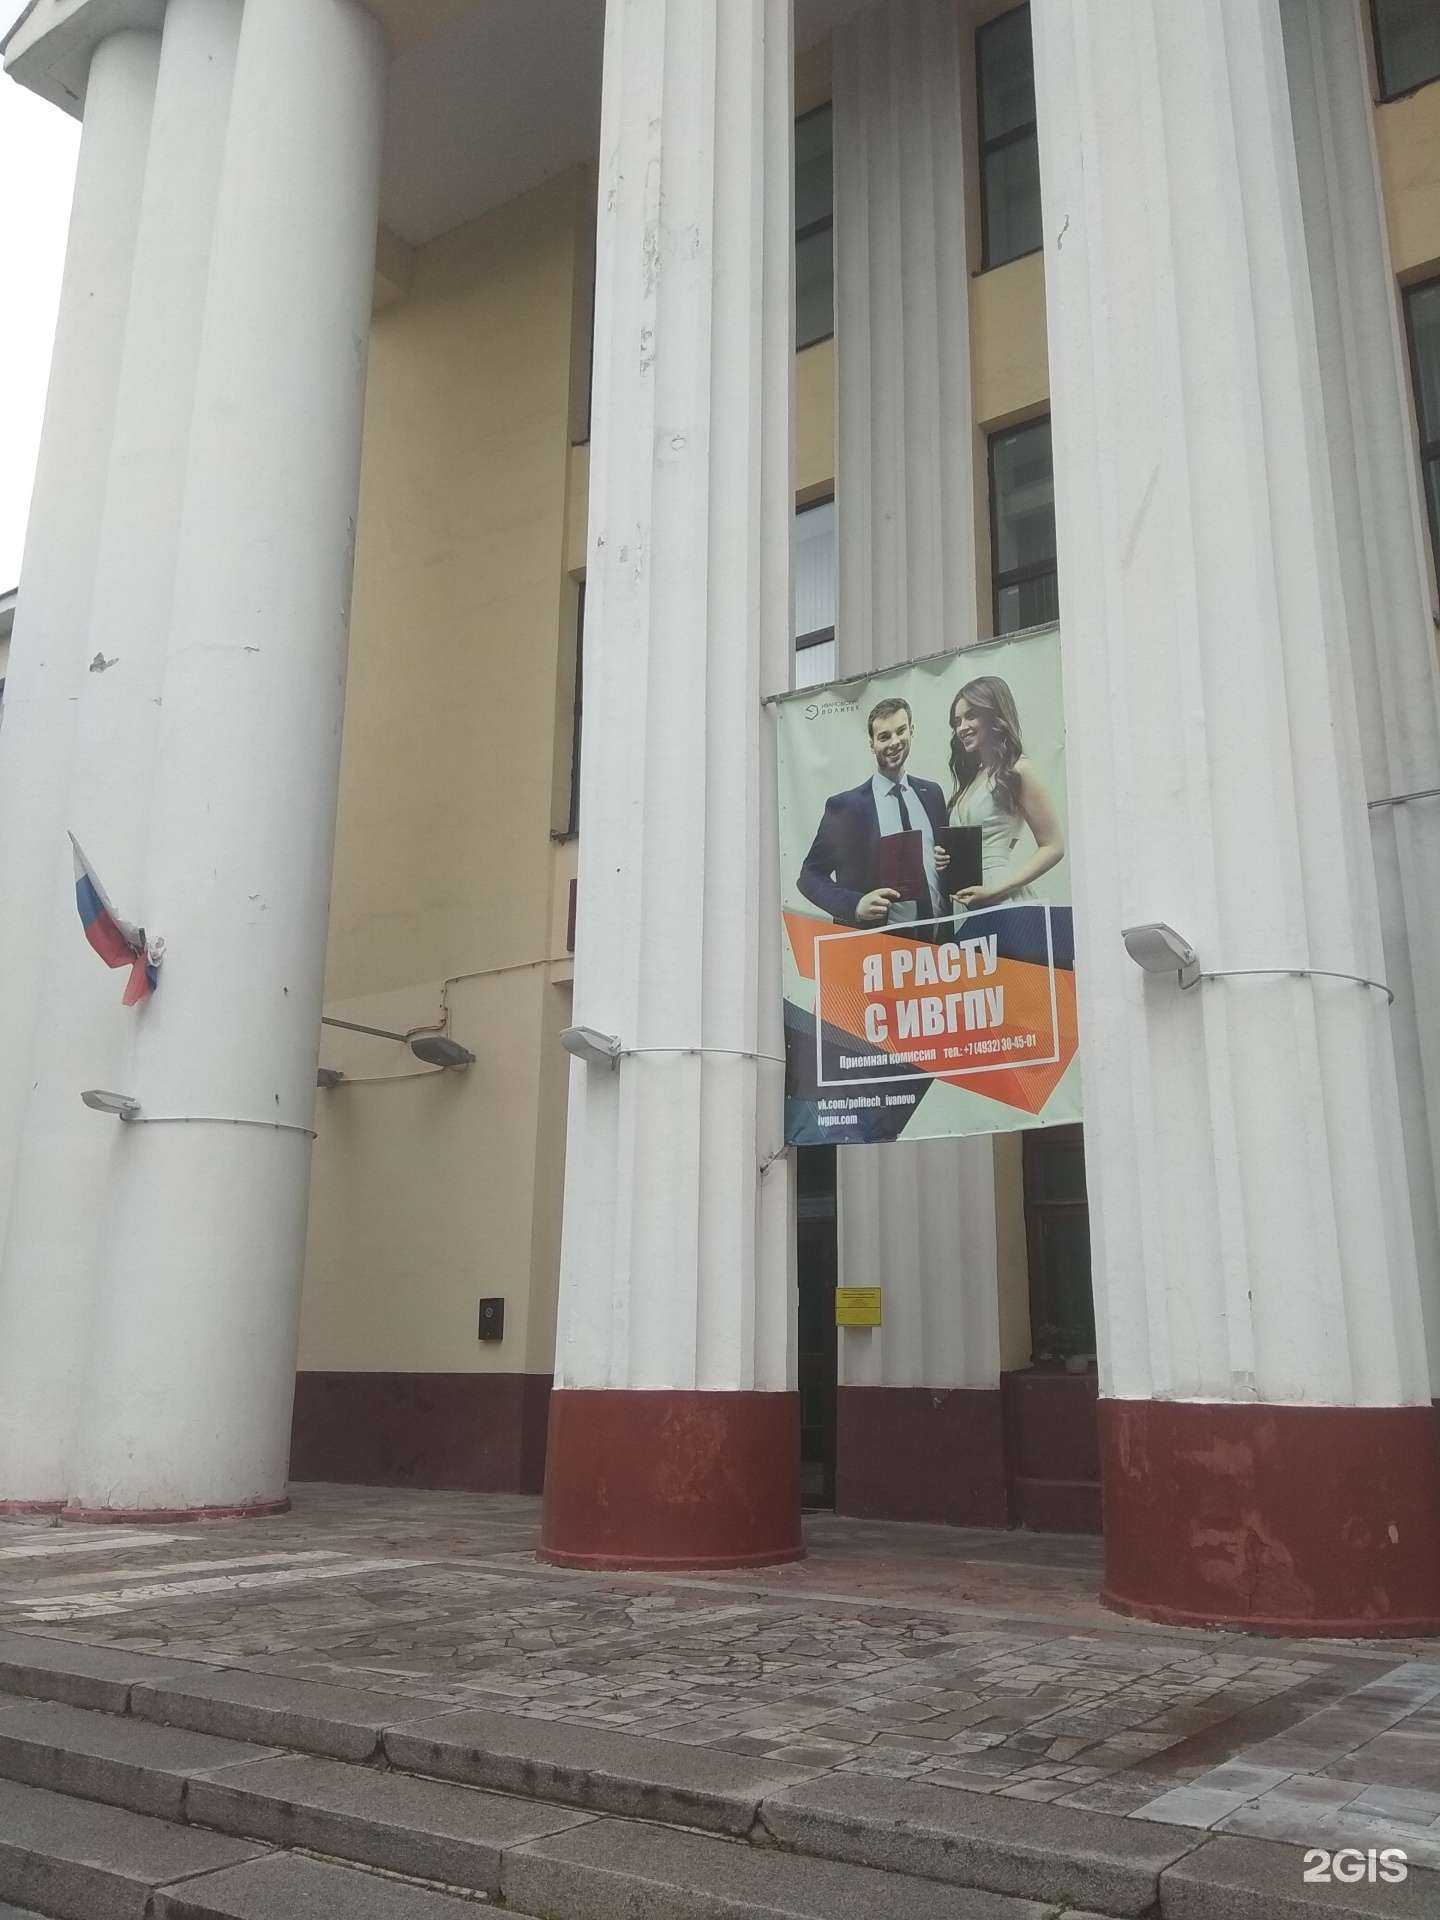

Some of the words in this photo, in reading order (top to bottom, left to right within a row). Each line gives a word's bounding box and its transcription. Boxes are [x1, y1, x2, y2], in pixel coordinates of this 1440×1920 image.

[862, 953, 884, 993] Я
[890, 933, 998, 989] РАСТУ
[864, 1003, 888, 1043] С
[895, 985, 1004, 1040] ИВГПУ
[839, 1054, 888, 1070] Приемная
[889, 1048, 937, 1064] комиссия
[817, 1094, 916, 1110] vk.com/politech_ivanovo
[817, 1114, 858, 1127] ivgpu.com
